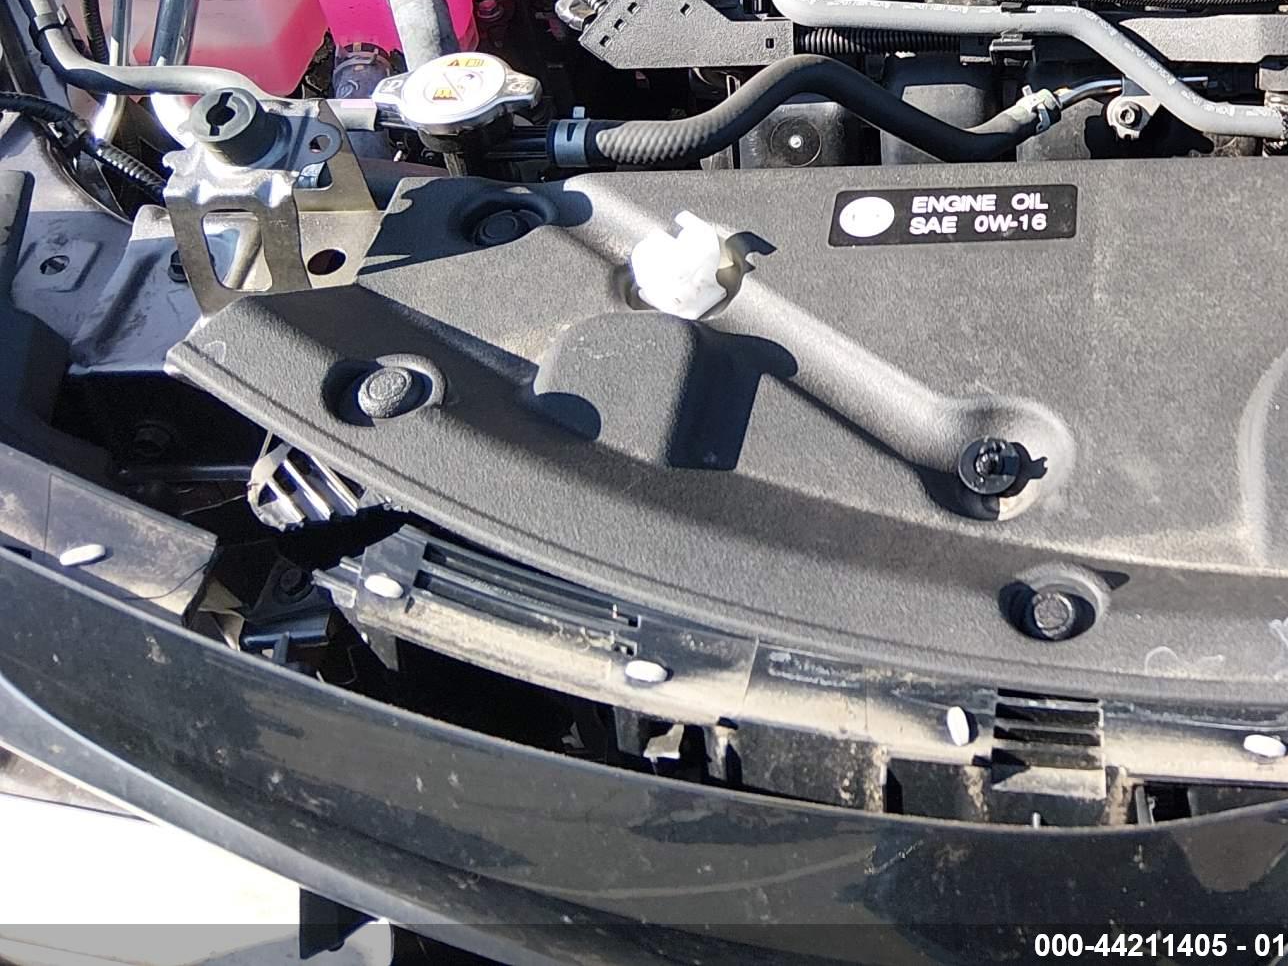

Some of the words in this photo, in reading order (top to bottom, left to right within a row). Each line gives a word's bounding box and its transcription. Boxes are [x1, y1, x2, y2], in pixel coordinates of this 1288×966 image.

[911, 193, 997, 214] ENGINE
[1011, 192, 1049, 211] OIL
[909, 215, 958, 235] SAE
[974, 212, 1048, 233] 0W-16
